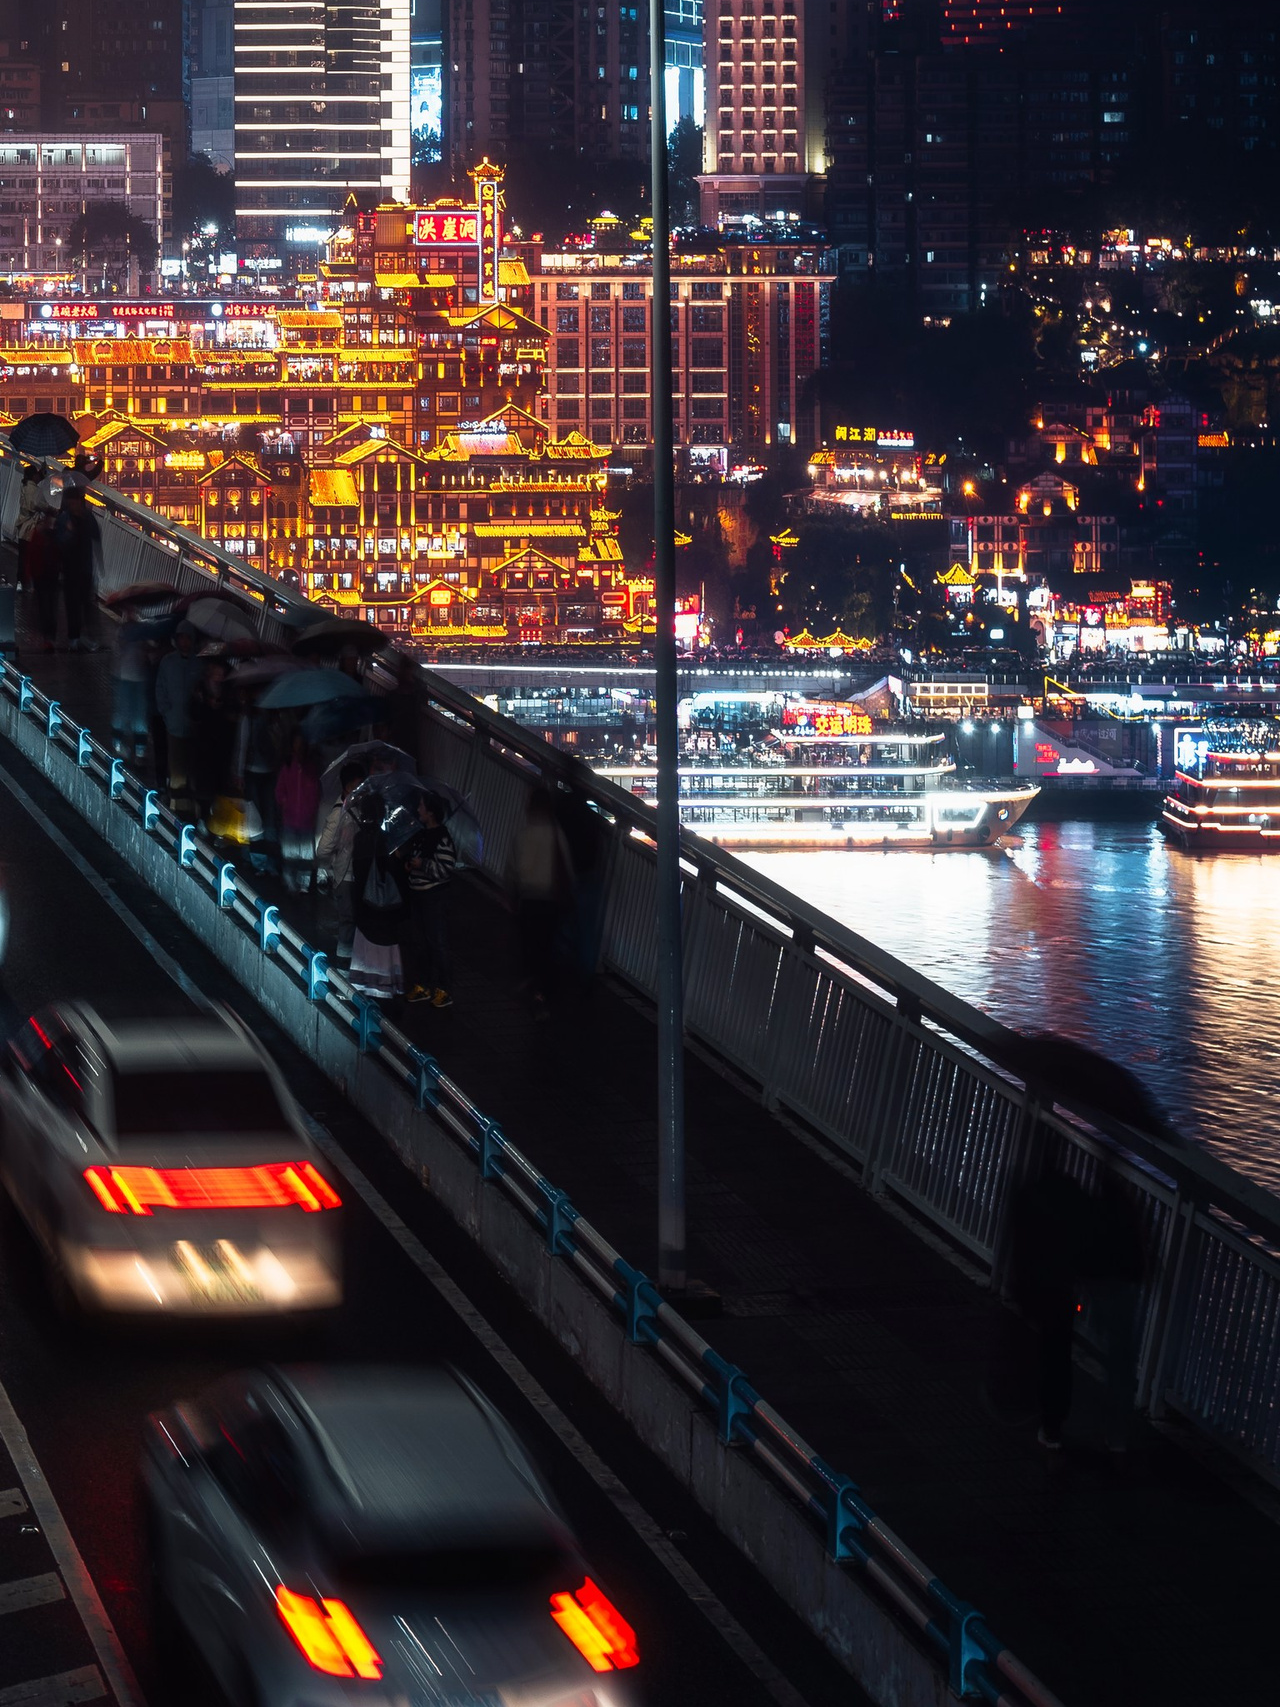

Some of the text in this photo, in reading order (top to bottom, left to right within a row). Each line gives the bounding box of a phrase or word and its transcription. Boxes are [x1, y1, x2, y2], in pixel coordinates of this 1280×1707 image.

[418, 216, 477, 241] 洪崖洞
[815, 714, 873, 735] 交运明珠
